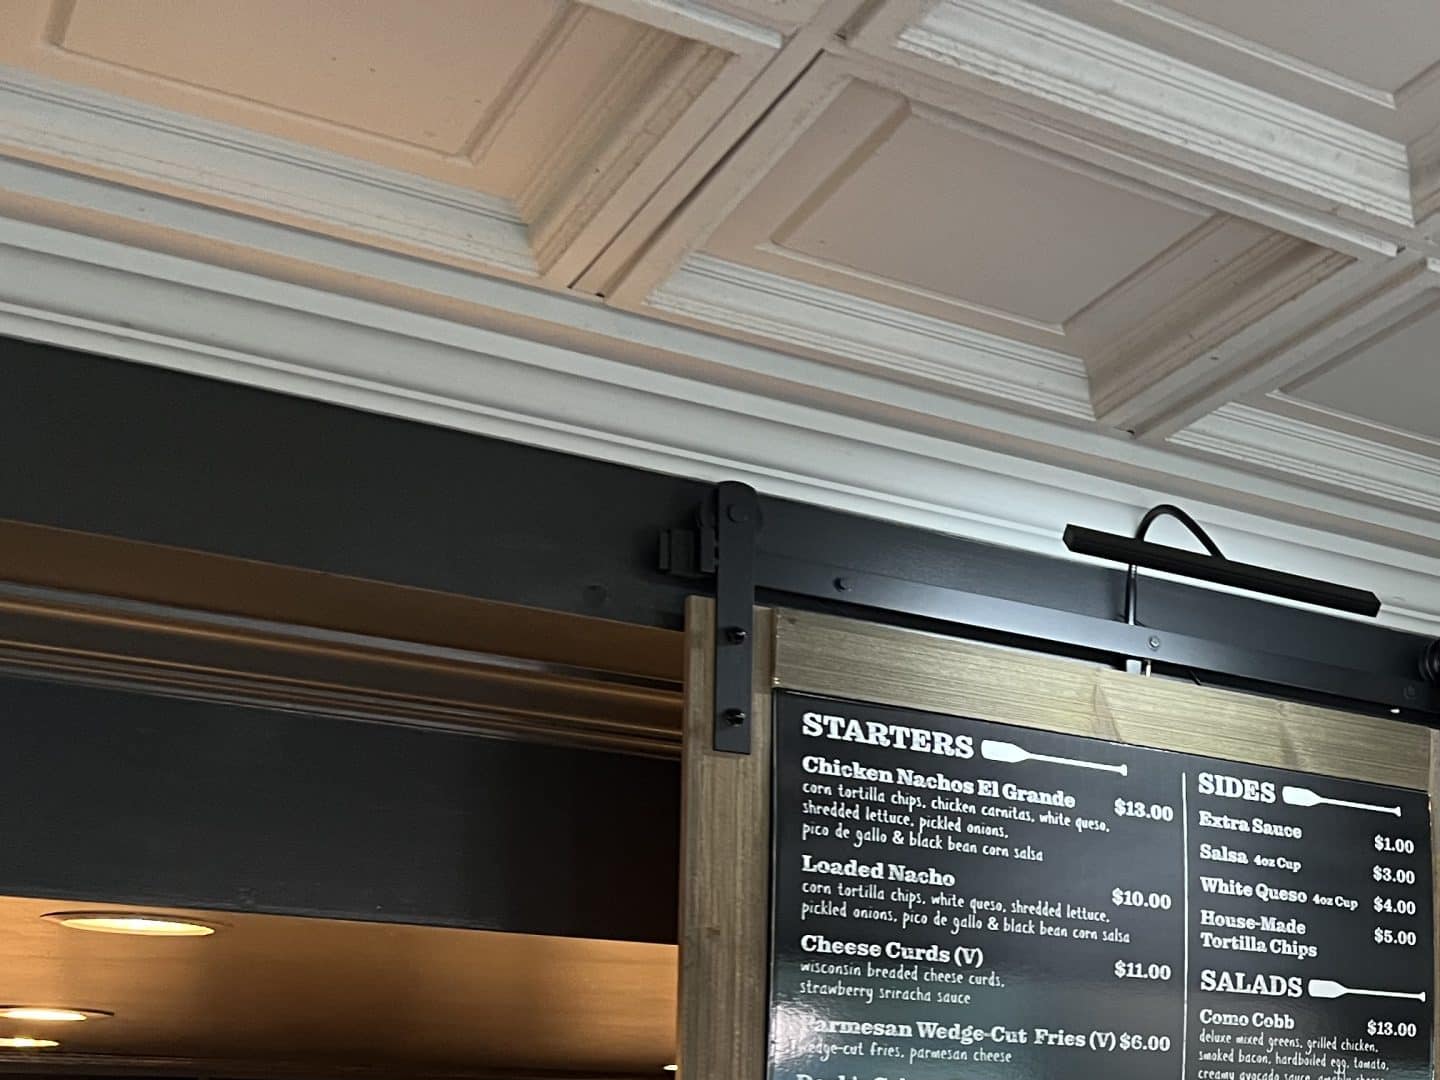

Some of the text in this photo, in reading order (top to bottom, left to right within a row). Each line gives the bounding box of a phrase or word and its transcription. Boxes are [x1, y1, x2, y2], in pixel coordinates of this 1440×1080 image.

[802, 712, 974, 759] STARTERS
[802, 756, 1173, 821] Chicken Nachos El Grande $13.00
[1198, 772, 1276, 803] SIDES
[1199, 810, 1414, 854] Extra Sauce $1.00
[1200, 843, 1415, 884] Salsa 4oz Cup $3.00
[801, 854, 1171, 910] Loaded Nacho $10.00
[1200, 876, 1416, 915] White Queso 4oz Cup $4.00
[1200, 909, 1416, 946] House-Made $5.00
[801, 934, 1171, 980] Cheese Curds (V) $11.00
[1200, 932, 1317, 960] Tortilla Chips
[799, 980, 971, 1004] strawberry sriracha sauce
[800, 962, 1005, 988] wisconsin breaded cheese curds,
[1201, 969, 1303, 998] SALADS
[809, 1018, 1170, 1051] armesan Wedge-Cut Fries (V) $6.00
[1199, 1009, 1417, 1037] Como Cobb $13.00
[1199, 1028, 1378, 1055] deluxe mixed greens, grilled chicken,
